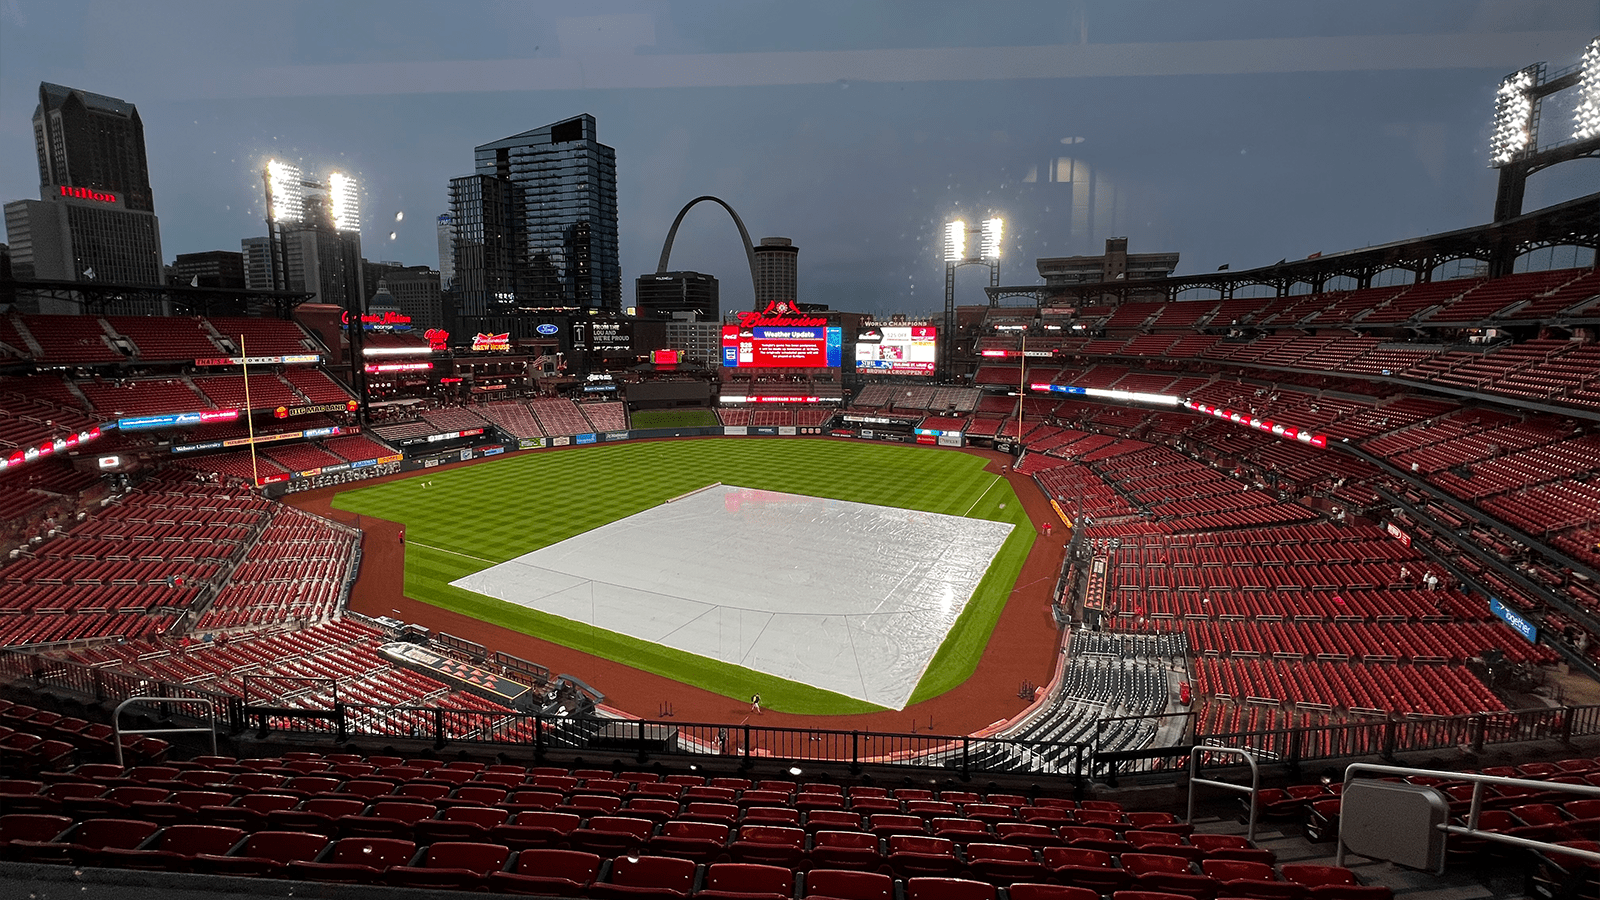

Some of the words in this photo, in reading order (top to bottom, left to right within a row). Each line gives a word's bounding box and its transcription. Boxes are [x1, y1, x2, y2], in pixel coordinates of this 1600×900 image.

[61, 186, 116, 202] Hilton
[380, 311, 411, 324] Nation
[737, 311, 828, 328] Budweiser
[791, 331, 815, 339] Update
[288, 407, 305, 416] BIG
[306, 405, 326, 414] MAC
[326, 404, 346, 412] LAND
[176, 444, 196, 452] Webster
[196, 442, 221, 450] University
